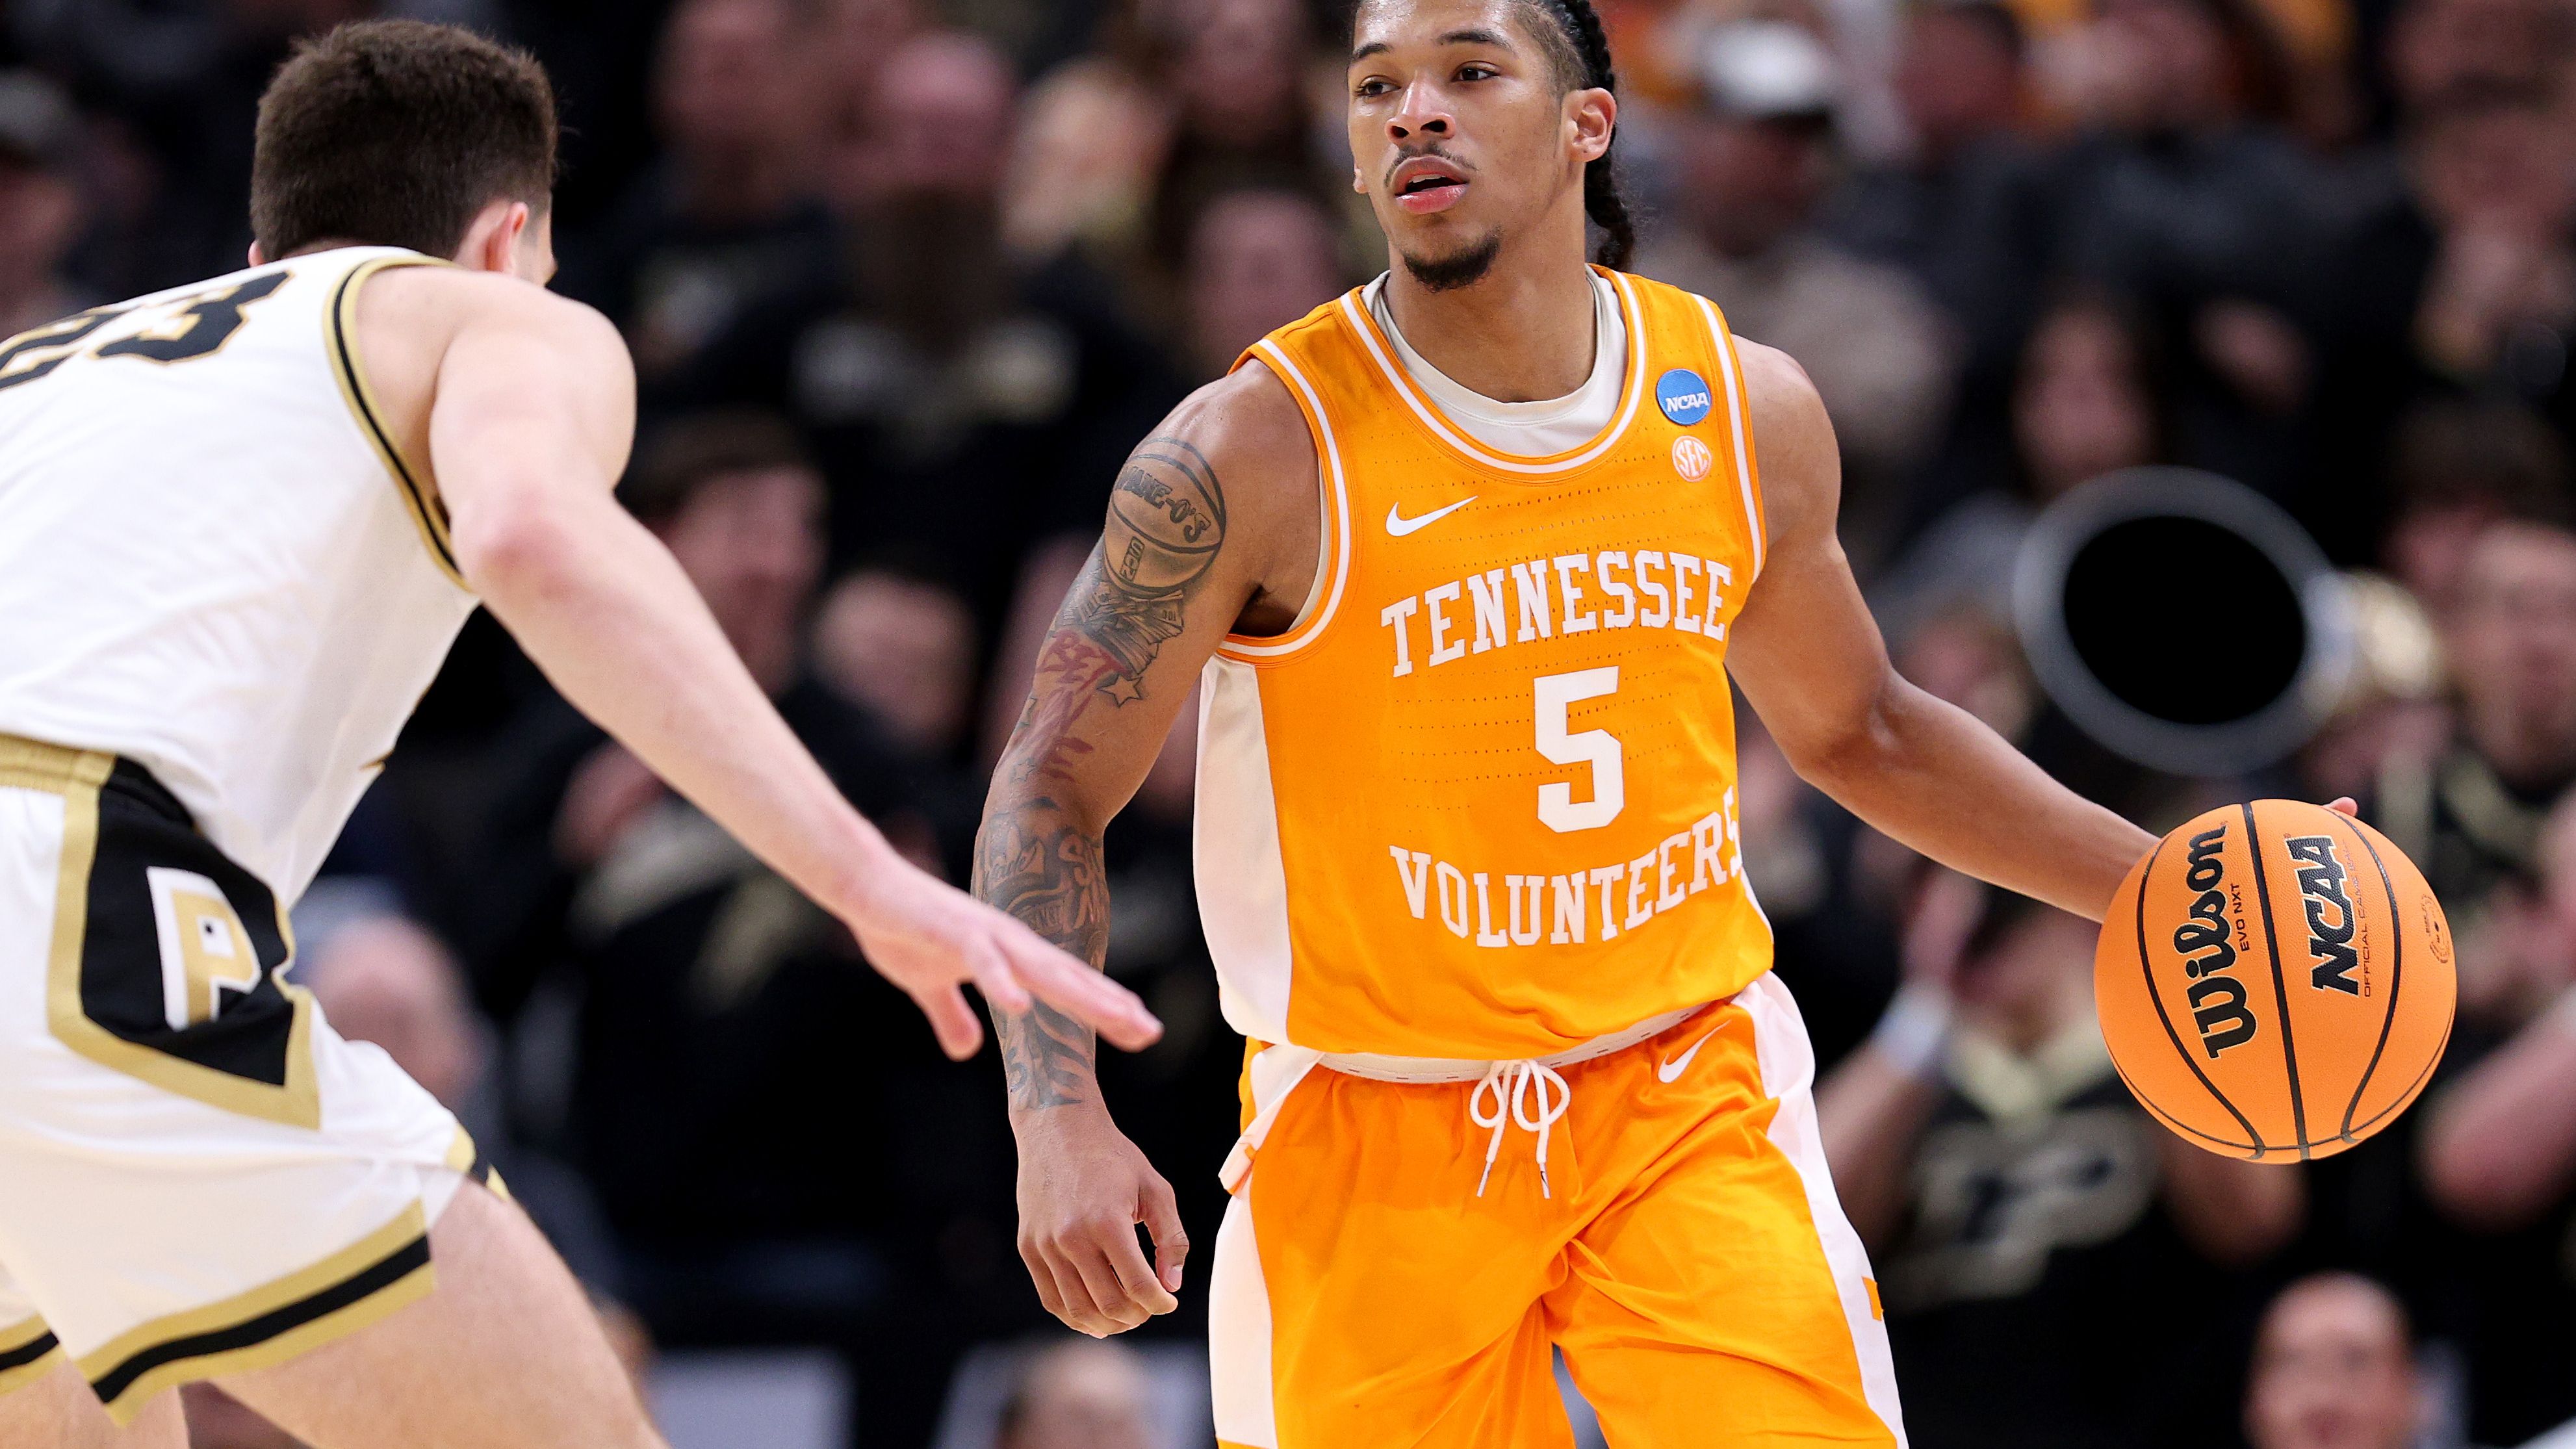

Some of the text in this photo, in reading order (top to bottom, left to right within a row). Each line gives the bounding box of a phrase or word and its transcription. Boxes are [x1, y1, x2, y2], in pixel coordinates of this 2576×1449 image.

[1665, 392, 1710, 413] NCAA
[1676, 439, 1708, 477] SEC
[1380, 549, 1732, 678] TENNESSEE
[1534, 665, 1625, 834] 5
[1389, 784, 1744, 948] VOLUNTEERS
[2230, 883, 2250, 952] EVO NXT
[2288, 835, 2359, 998] NCAA
[146, 866, 262, 1032] P
[2173, 823, 2258, 1060] Wilson
[2361, 923, 2371, 997] OFFICIAL
